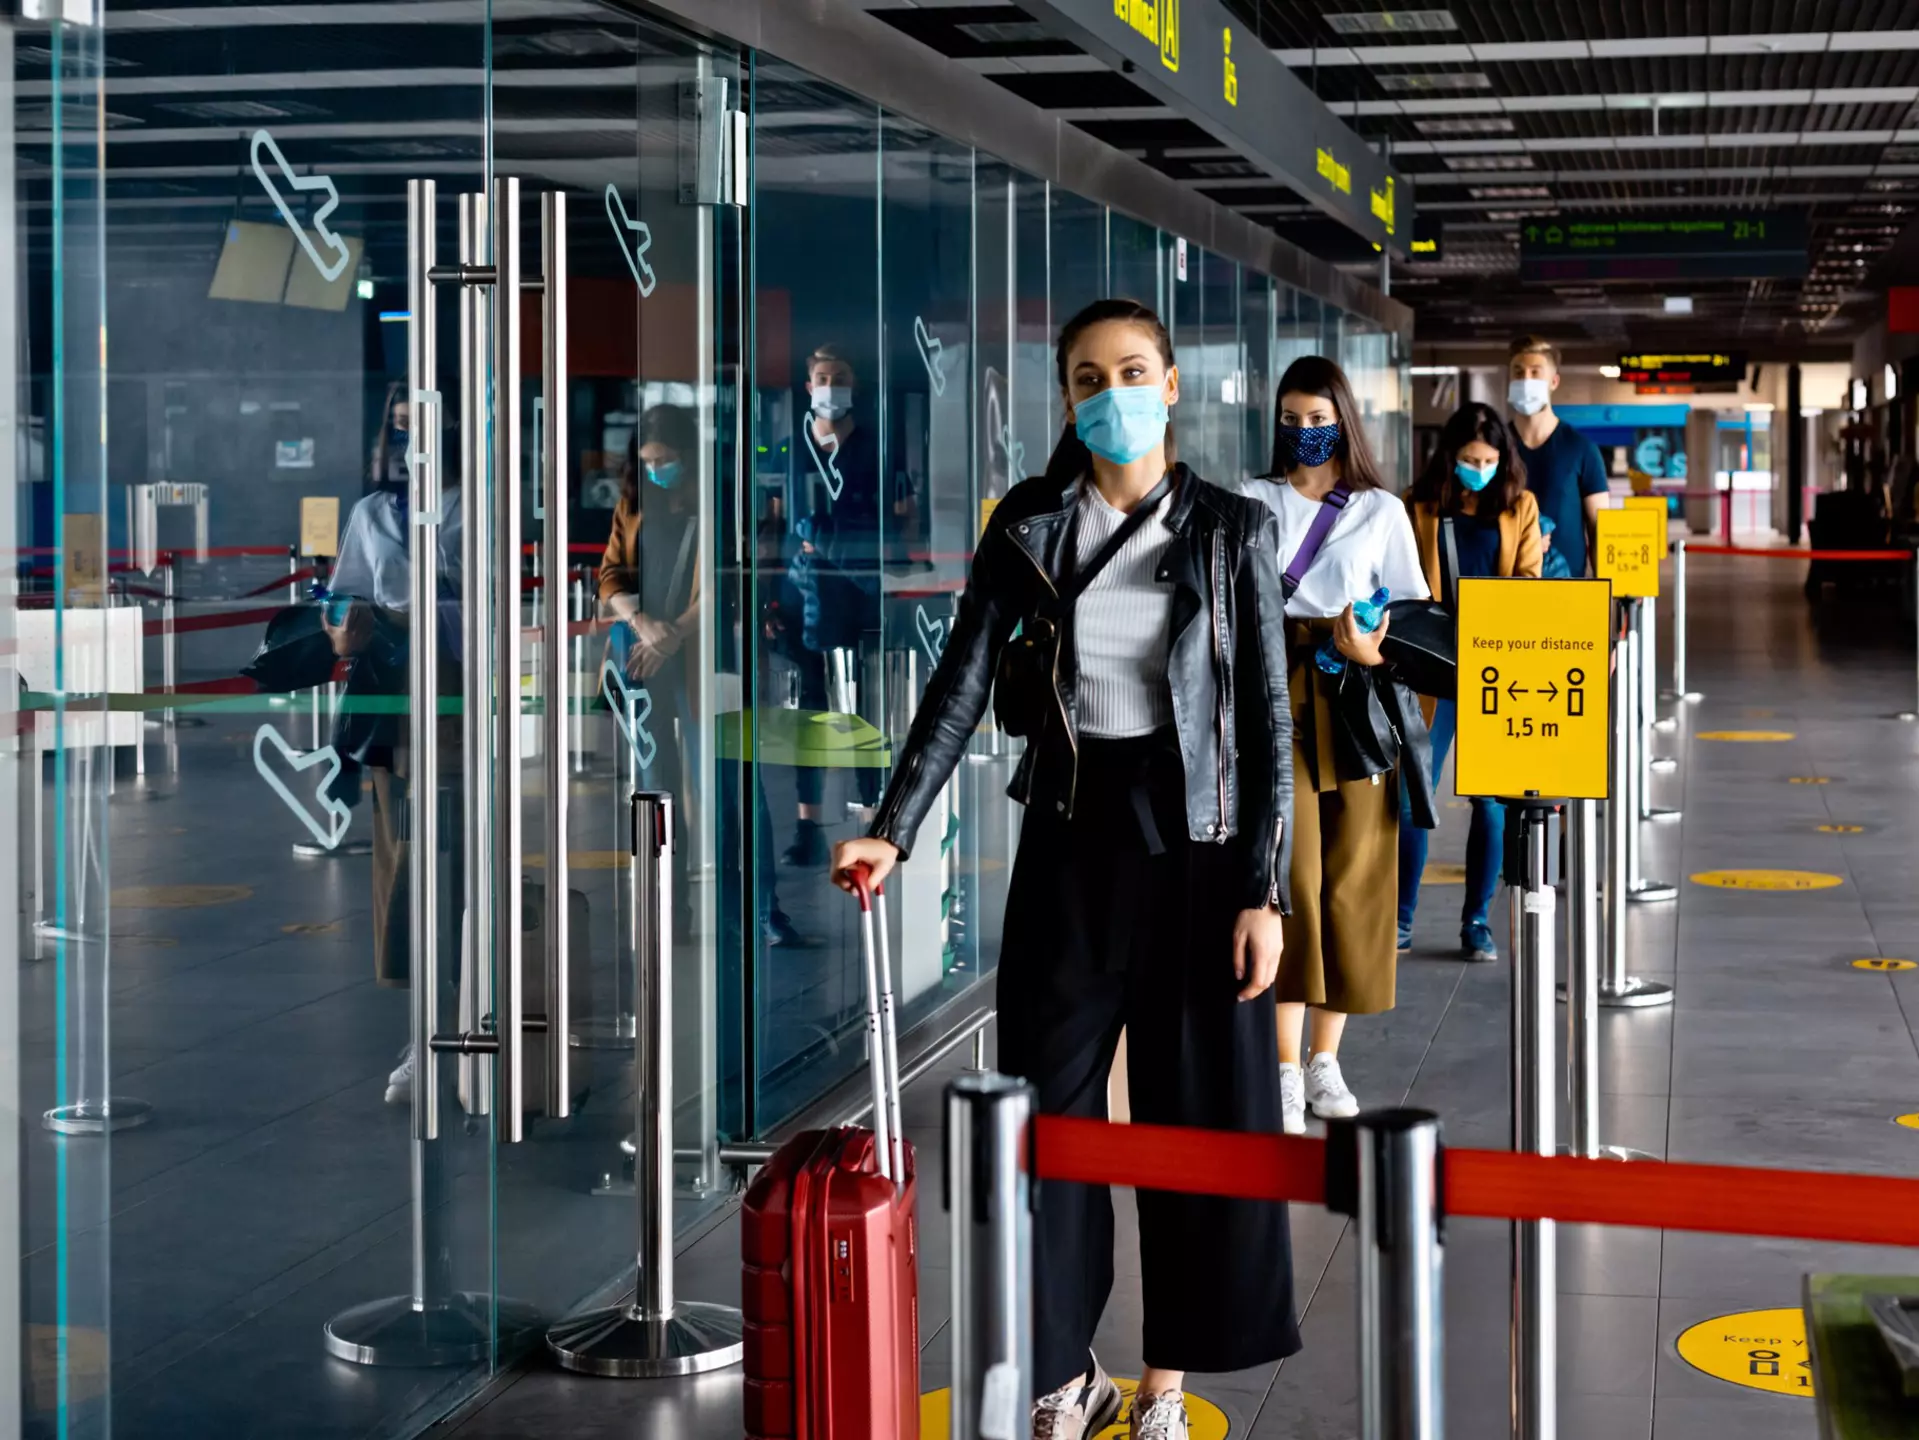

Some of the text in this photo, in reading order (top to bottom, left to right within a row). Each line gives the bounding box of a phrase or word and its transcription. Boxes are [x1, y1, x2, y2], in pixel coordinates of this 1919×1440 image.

[1472, 636, 1594, 652] Keep your distance
[1506, 717, 1558, 738] 1,5 m
[1724, 1335, 1782, 1345] Keep
